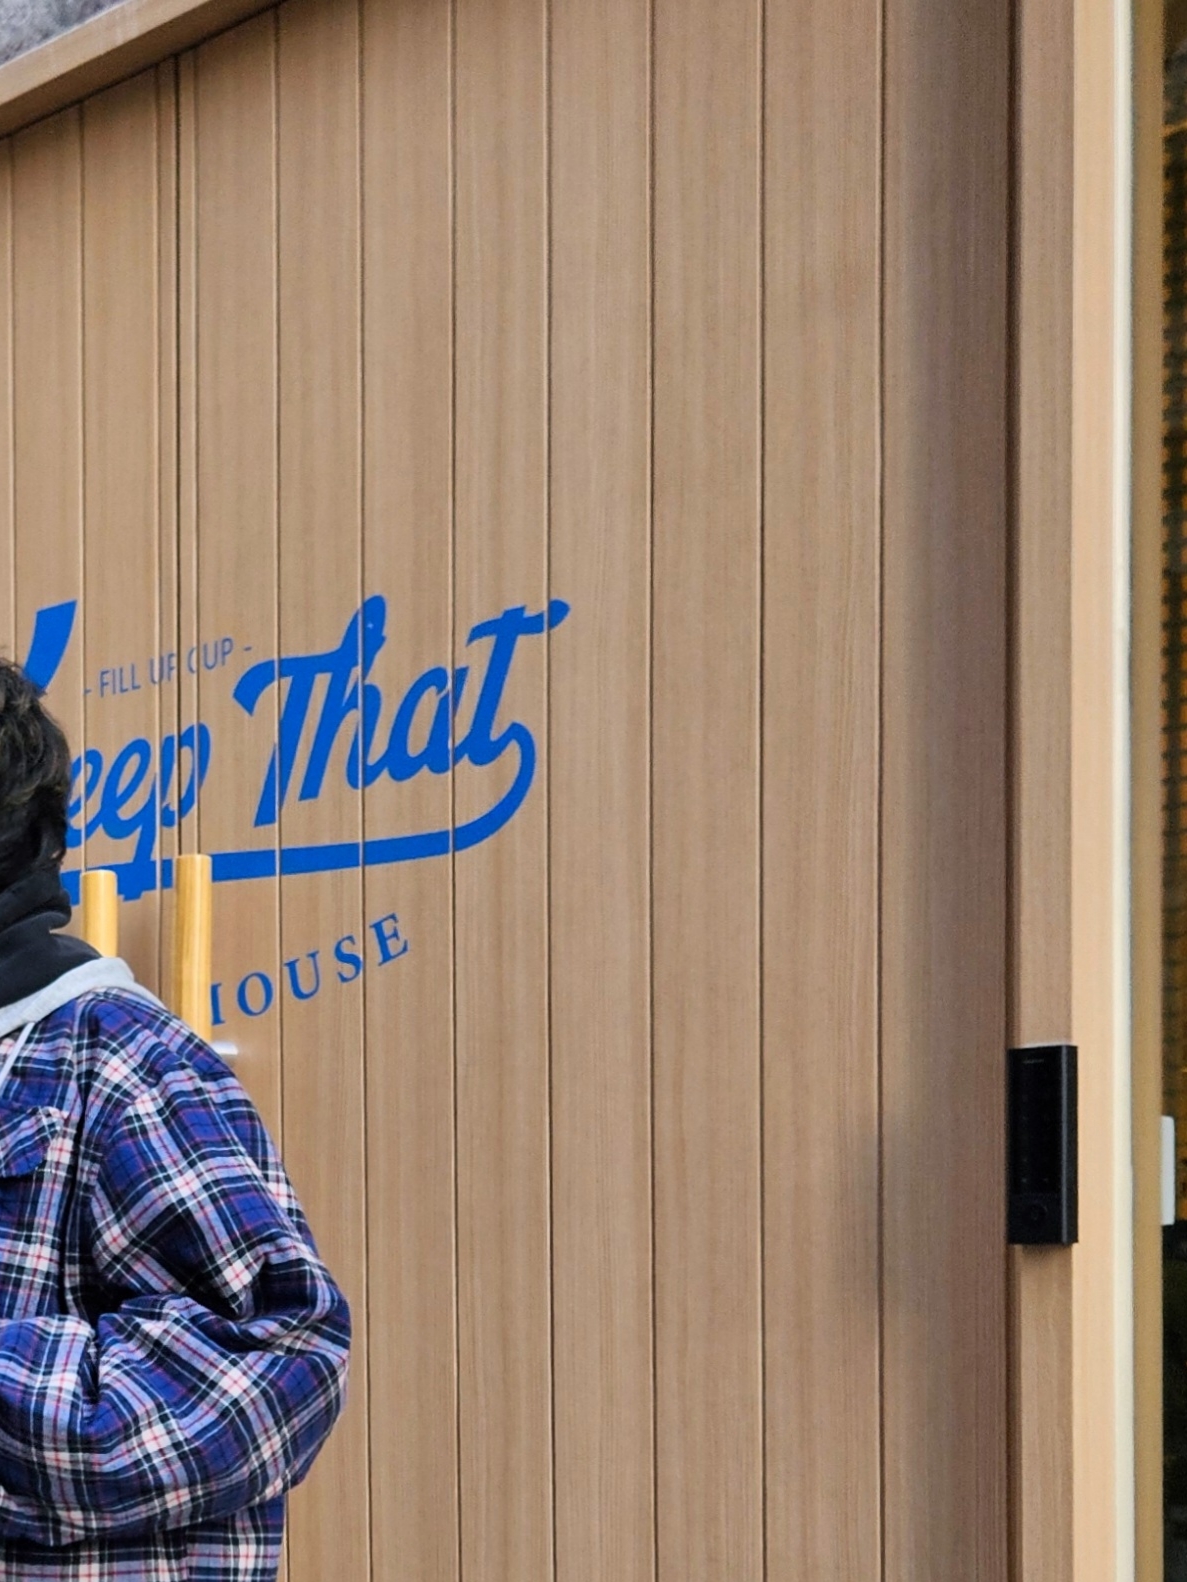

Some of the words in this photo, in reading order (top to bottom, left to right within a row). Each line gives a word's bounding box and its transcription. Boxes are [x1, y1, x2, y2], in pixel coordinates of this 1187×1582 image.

[99, 663, 141, 698] FILL
[187, 636, 234, 675] CUP
[232, 594, 571, 828] That
